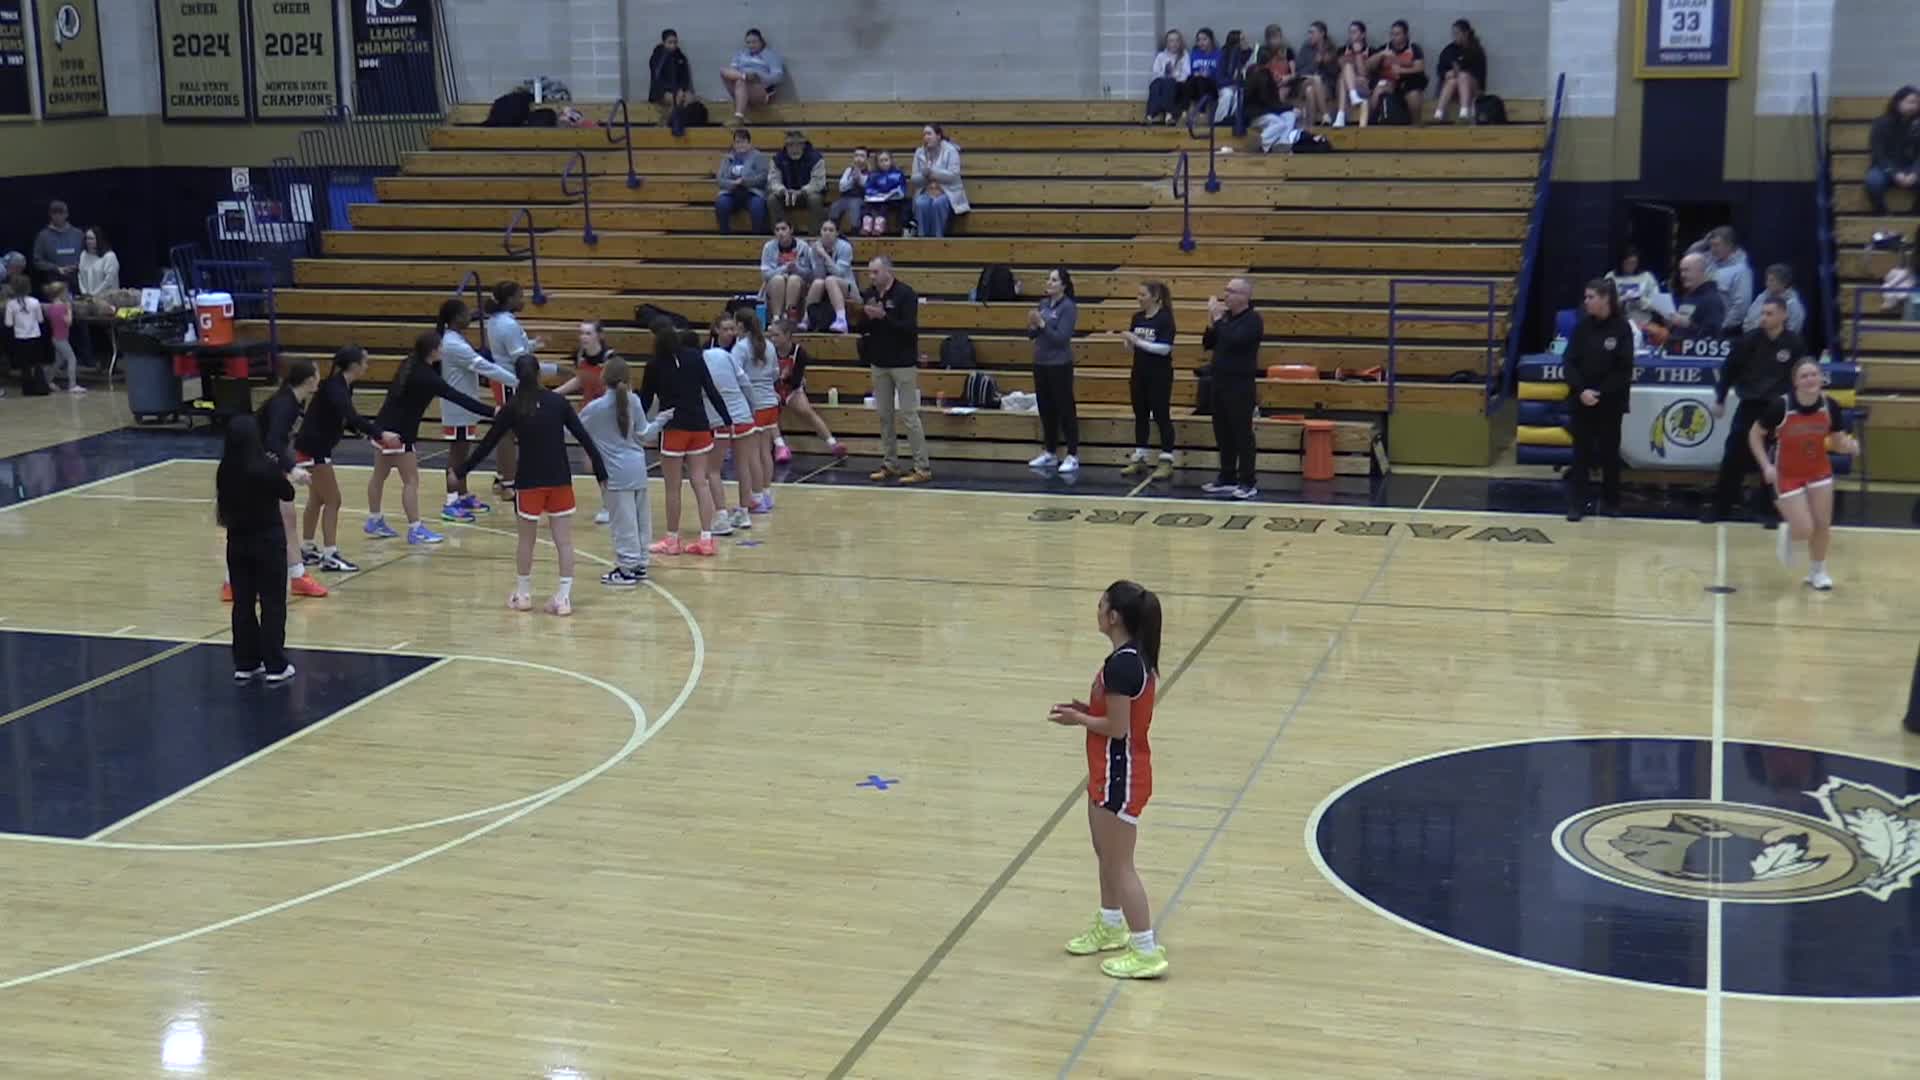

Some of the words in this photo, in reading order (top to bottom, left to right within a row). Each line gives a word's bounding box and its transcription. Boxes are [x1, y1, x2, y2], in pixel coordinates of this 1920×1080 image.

[181, 3, 218, 15] CHEER
[273, 3, 311, 14] CHEER
[1673, 11, 1700, 31] 33
[369, 26, 416, 40] LEAGUE
[172, 32, 231, 57] 2024
[265, 32, 323, 57] 2024
[357, 41, 430, 55] CHAMPIONS
[265, 82, 299, 92] WINTER
[300, 80, 329, 91] STATE
[170, 94, 240, 106] CHAMPIONS
[262, 94, 333, 106] CHAMPIONS
[200, 313, 213, 329] G
[1682, 339, 1731, 356] POSS
[1631, 367, 1646, 381] F
[1655, 367, 1702, 383] THE
[1027, 508, 1554, 545] WARRIORS
